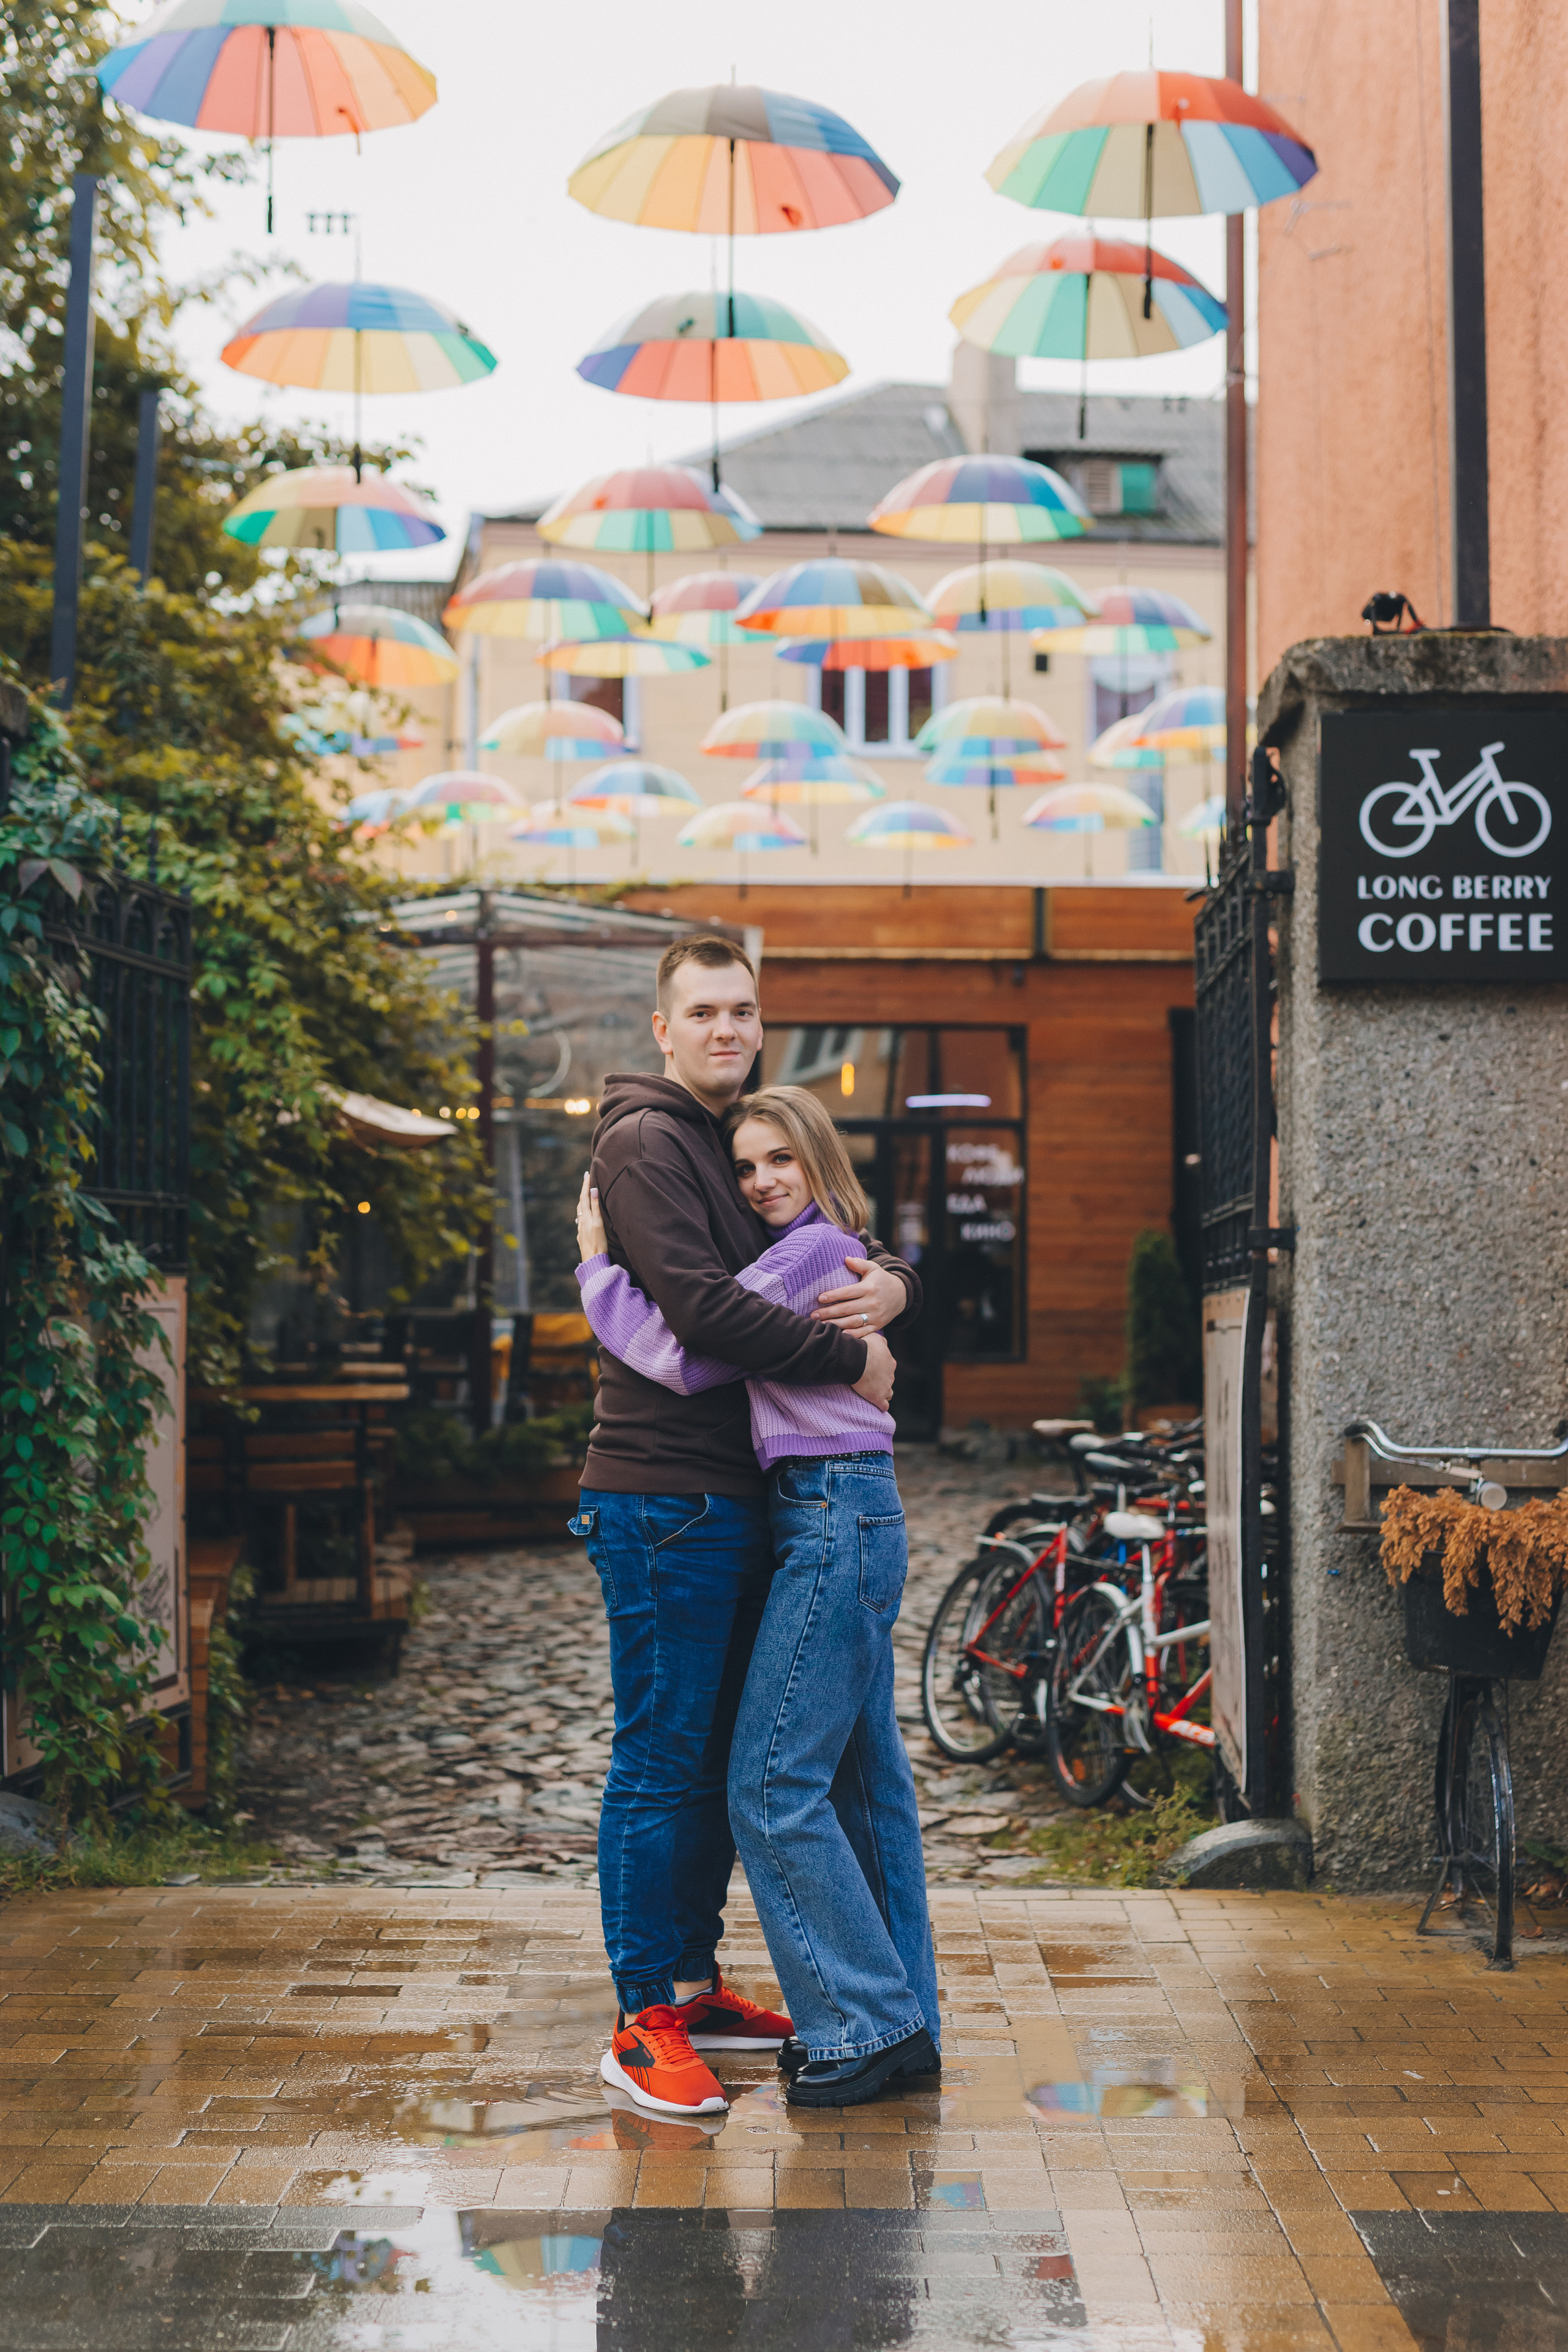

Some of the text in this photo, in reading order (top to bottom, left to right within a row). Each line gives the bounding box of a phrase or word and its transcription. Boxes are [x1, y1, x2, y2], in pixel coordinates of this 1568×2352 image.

[1357, 875, 1551, 900] LONG BERRY
[1357, 912, 1554, 952] COFFEE
